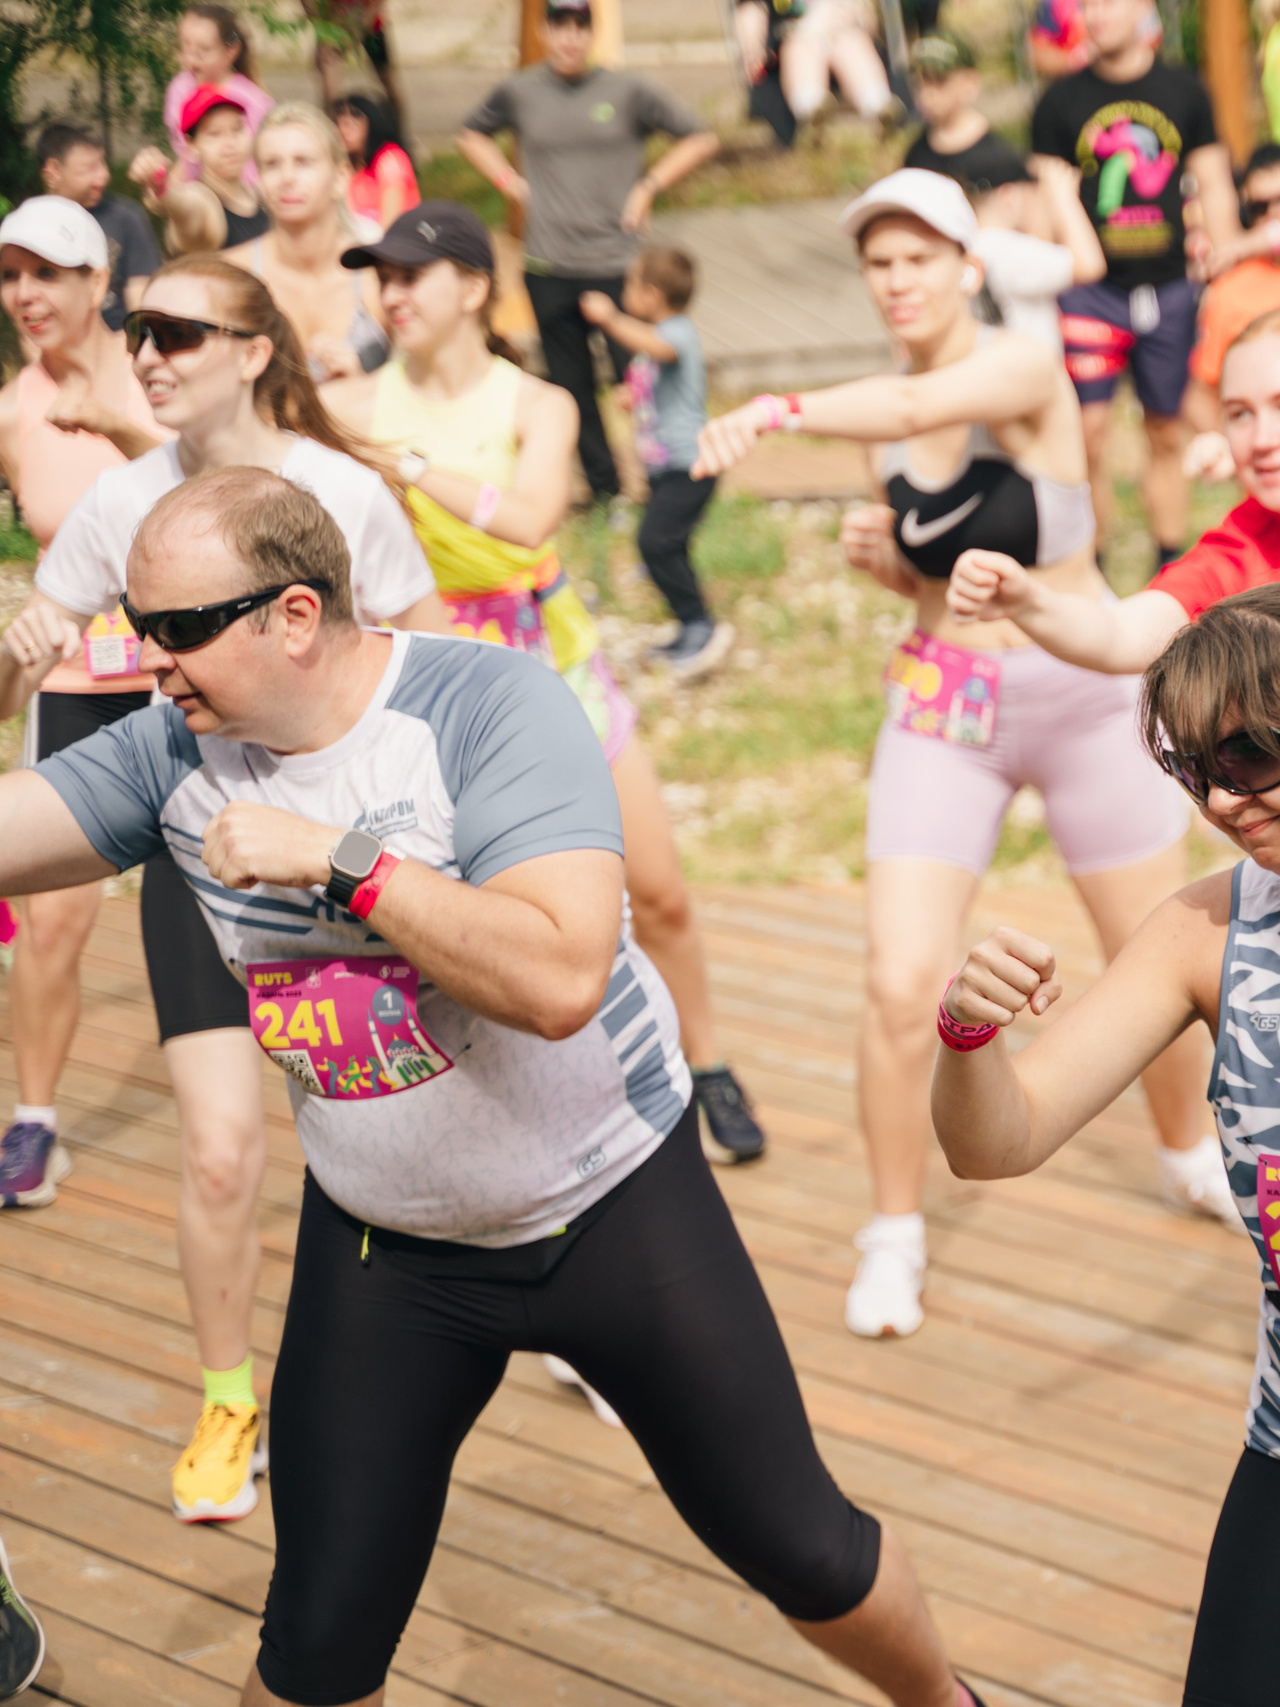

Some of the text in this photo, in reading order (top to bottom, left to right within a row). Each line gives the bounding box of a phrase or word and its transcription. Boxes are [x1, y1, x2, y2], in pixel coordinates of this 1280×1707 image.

[254, 972, 293, 987] RUTS
[383, 991, 393, 1009] 1
[254, 998, 343, 1049] 241
